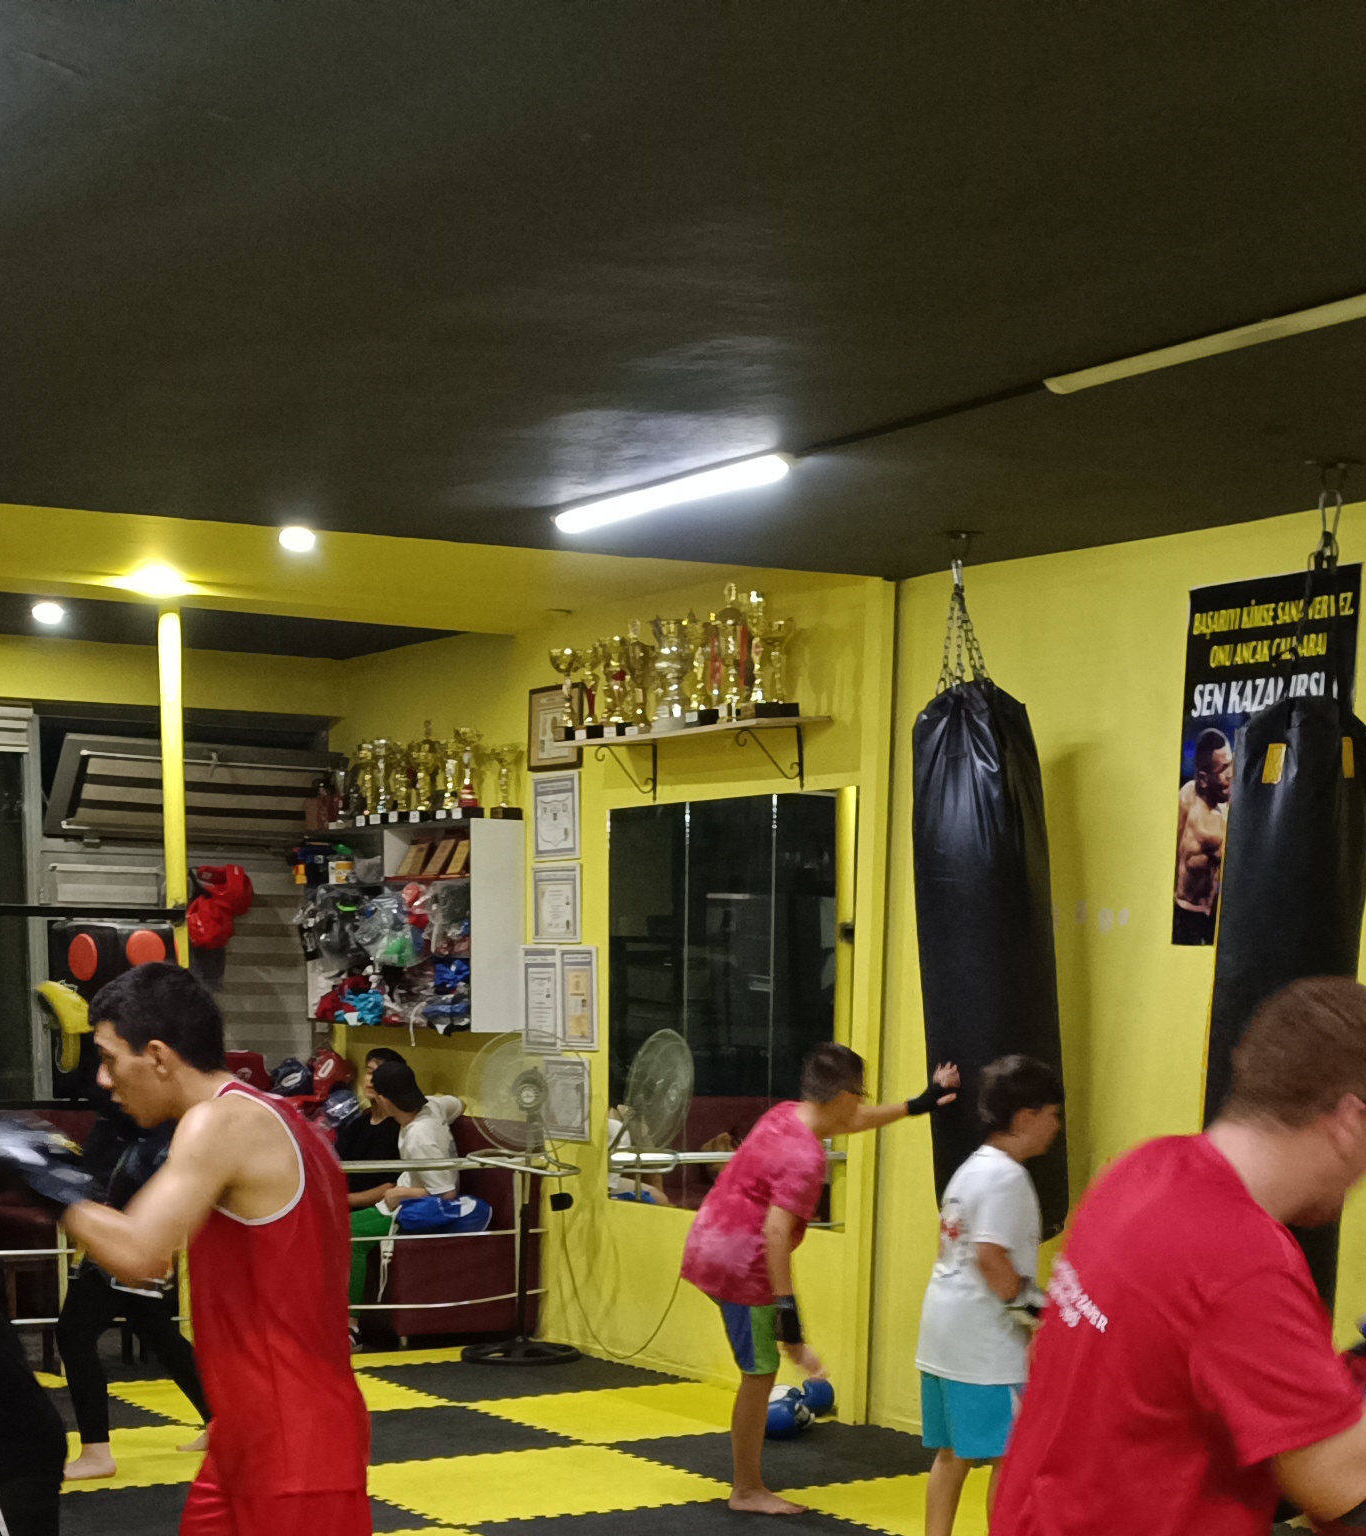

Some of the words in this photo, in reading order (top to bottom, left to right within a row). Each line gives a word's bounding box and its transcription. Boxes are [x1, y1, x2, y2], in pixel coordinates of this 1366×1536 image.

[1241, 599, 1275, 629] KİMSE
[1210, 644, 1234, 668] ONU
[1234, 640, 1271, 665] ANCAK
[1191, 683, 1226, 717] SEN
[1227, 672, 1338, 714] KAZAIRSI
